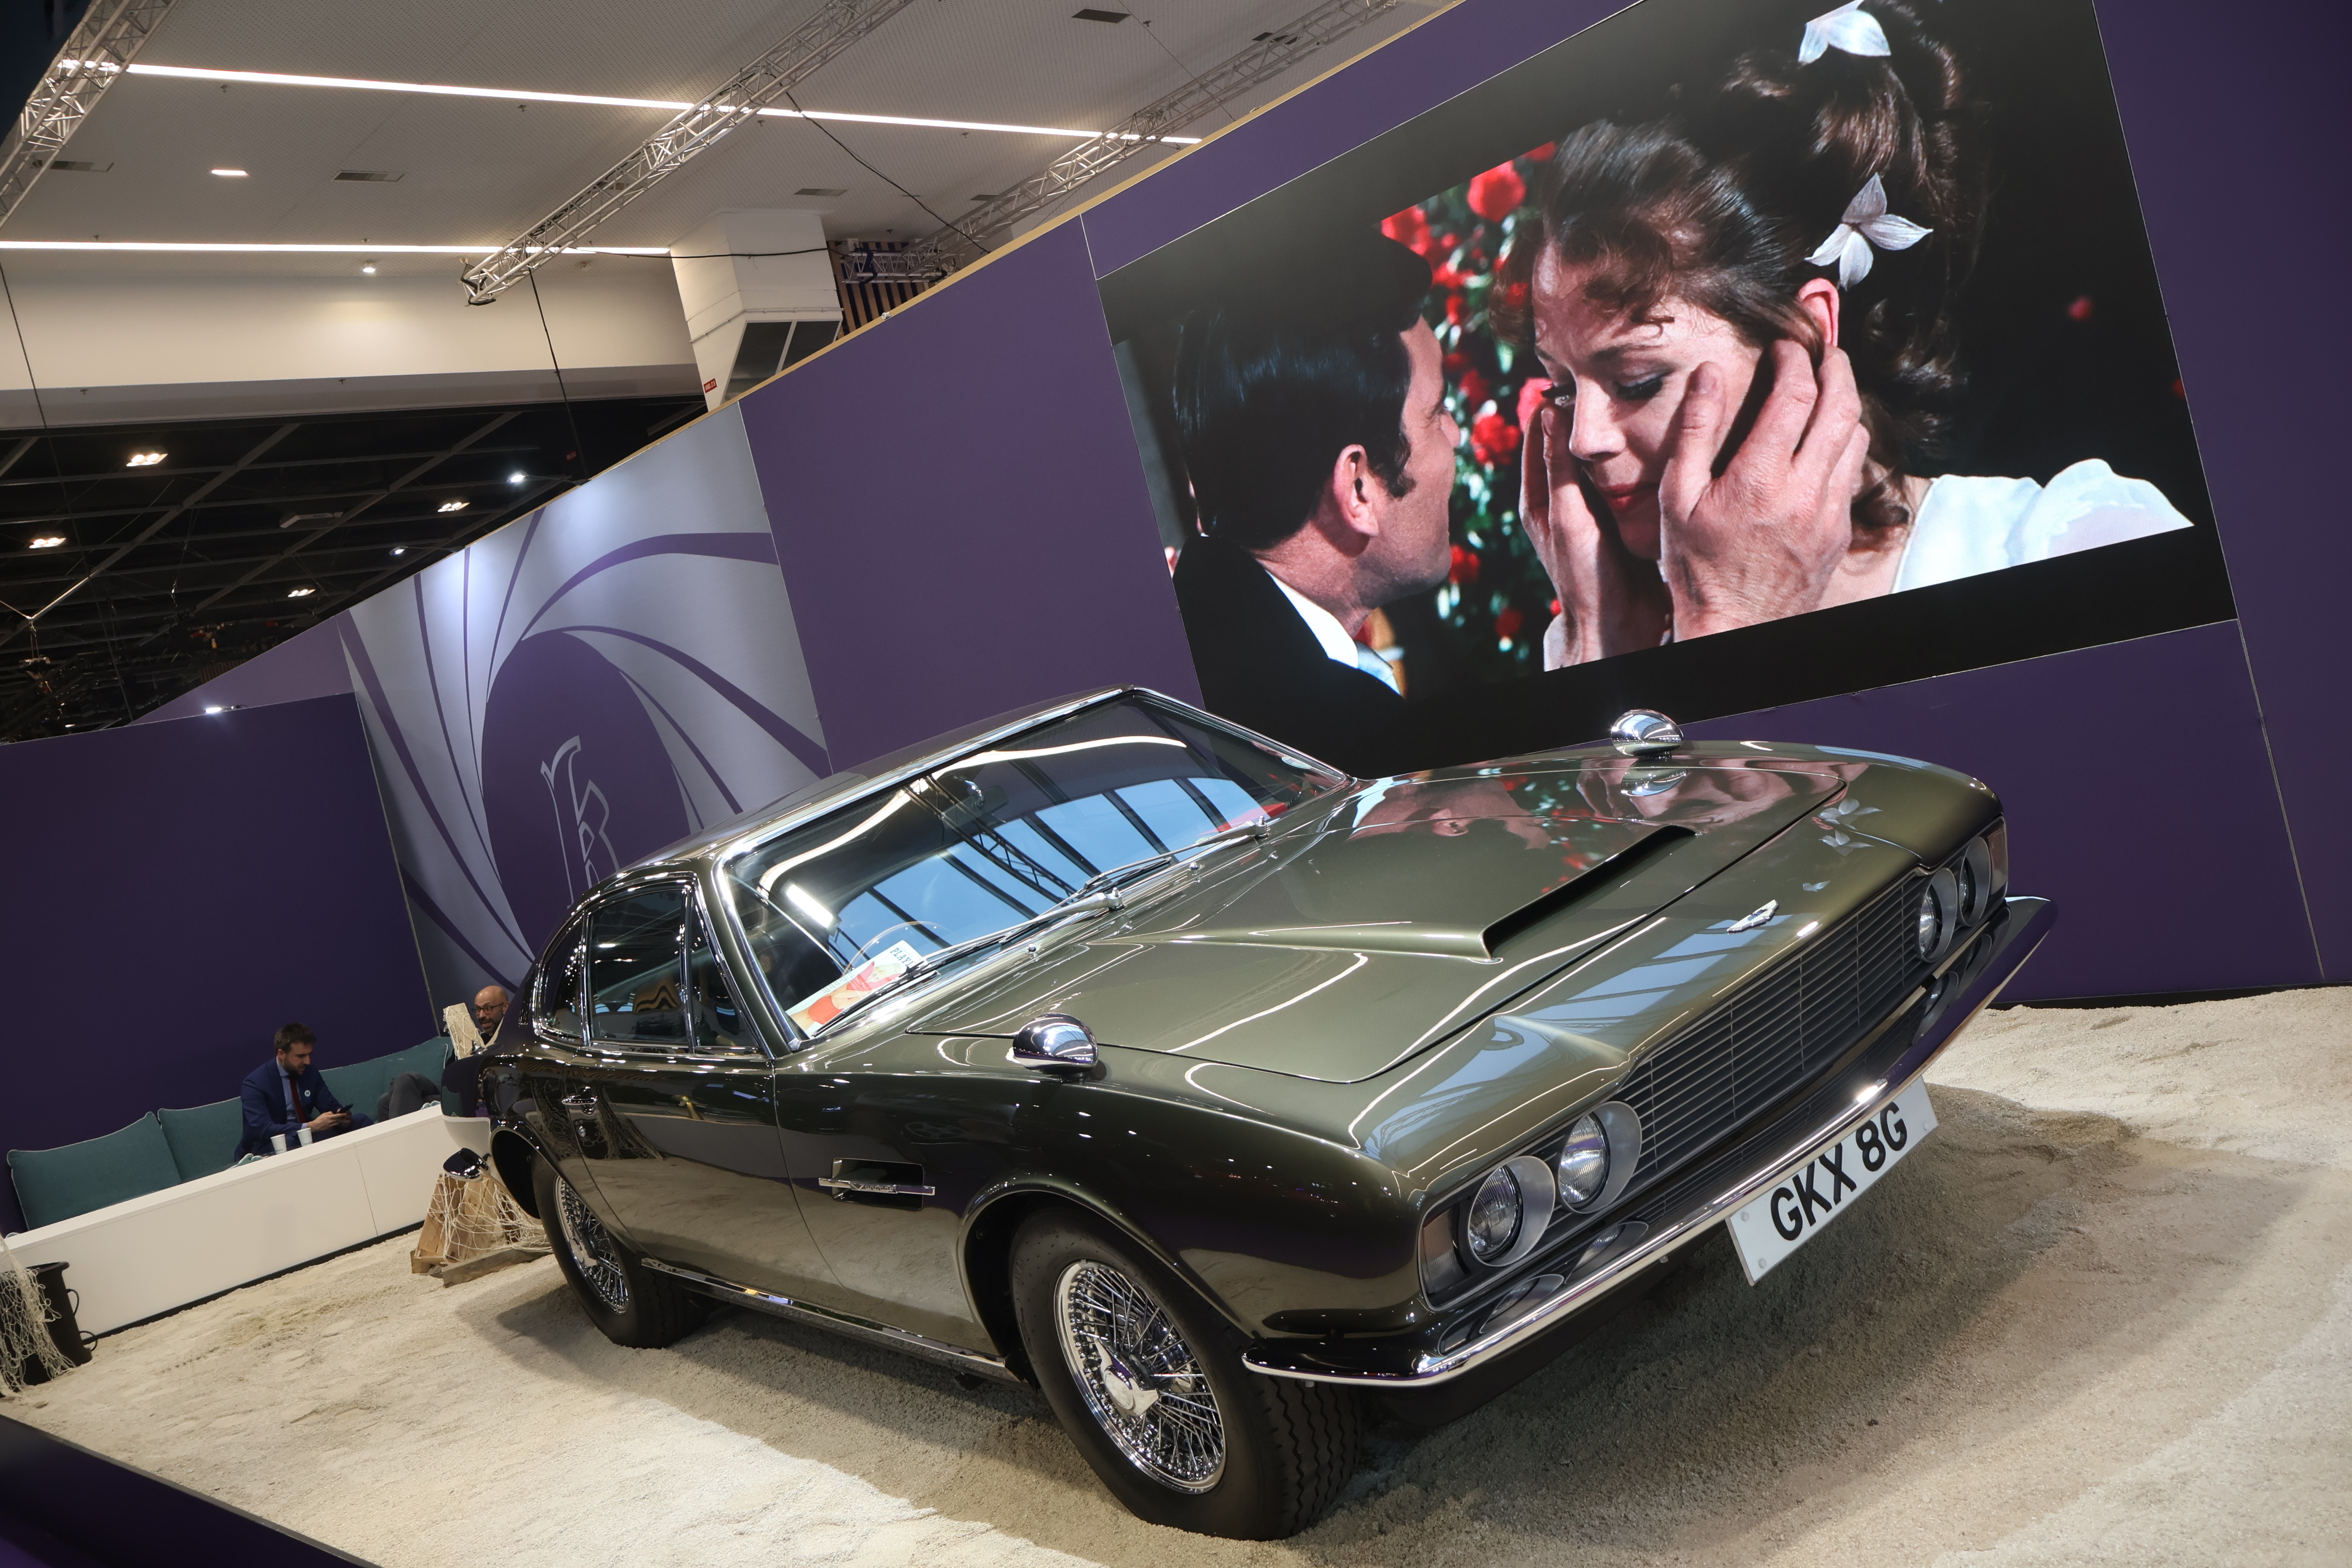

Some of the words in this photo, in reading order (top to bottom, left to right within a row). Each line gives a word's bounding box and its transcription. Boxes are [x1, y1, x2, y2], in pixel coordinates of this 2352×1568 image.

[850, 1183, 894, 1192] Vantage
[1770, 1141, 1857, 1241] GKX
[1855, 1102, 1907, 1172] 8G
